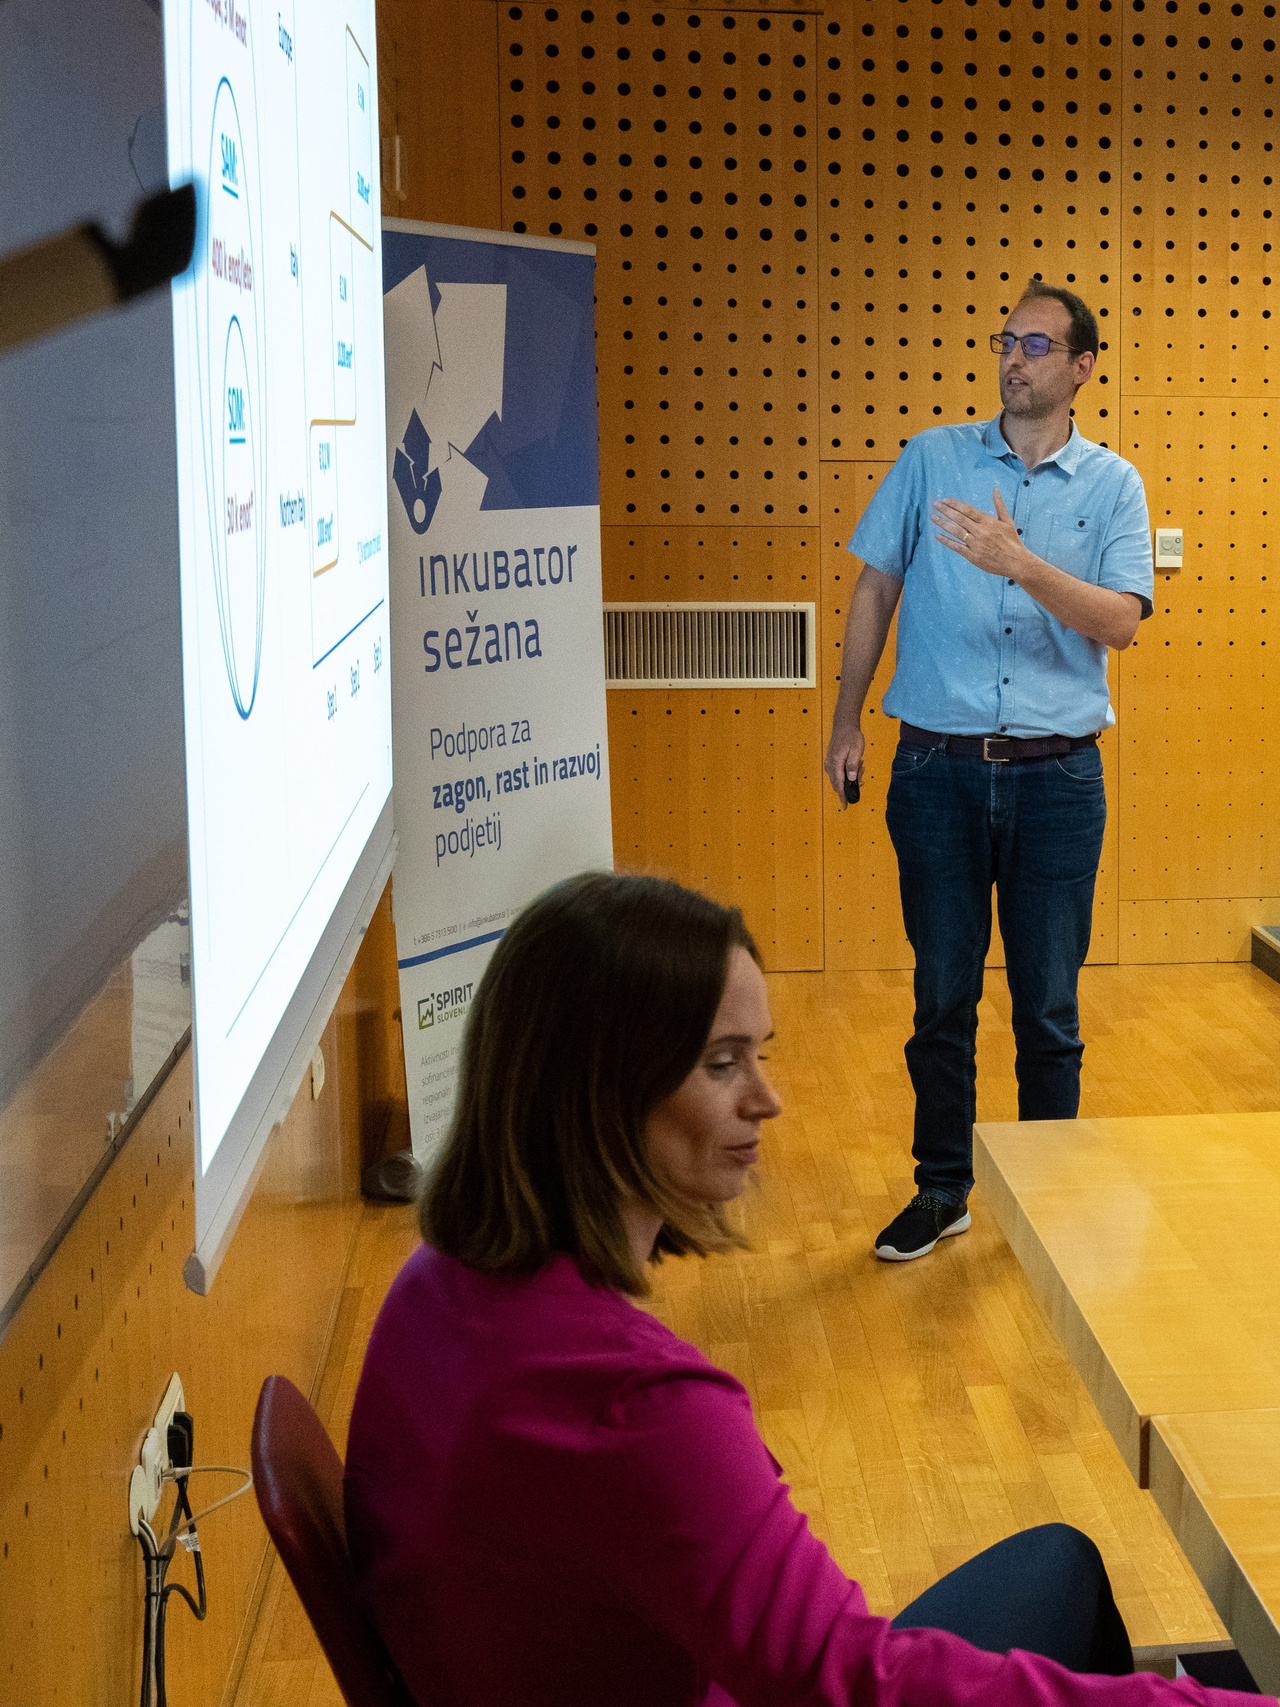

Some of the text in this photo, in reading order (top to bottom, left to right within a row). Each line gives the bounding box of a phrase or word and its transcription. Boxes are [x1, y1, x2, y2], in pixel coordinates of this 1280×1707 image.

[422, 609, 543, 673] sežana
[430, 719, 532, 763] Podpora za
[432, 743, 602, 814] zagon, rast in razvoj
[435, 811, 502, 867] podjetij
[436, 982, 474, 1012] SPIRIT
[437, 1004, 470, 1024] SLOVENI
